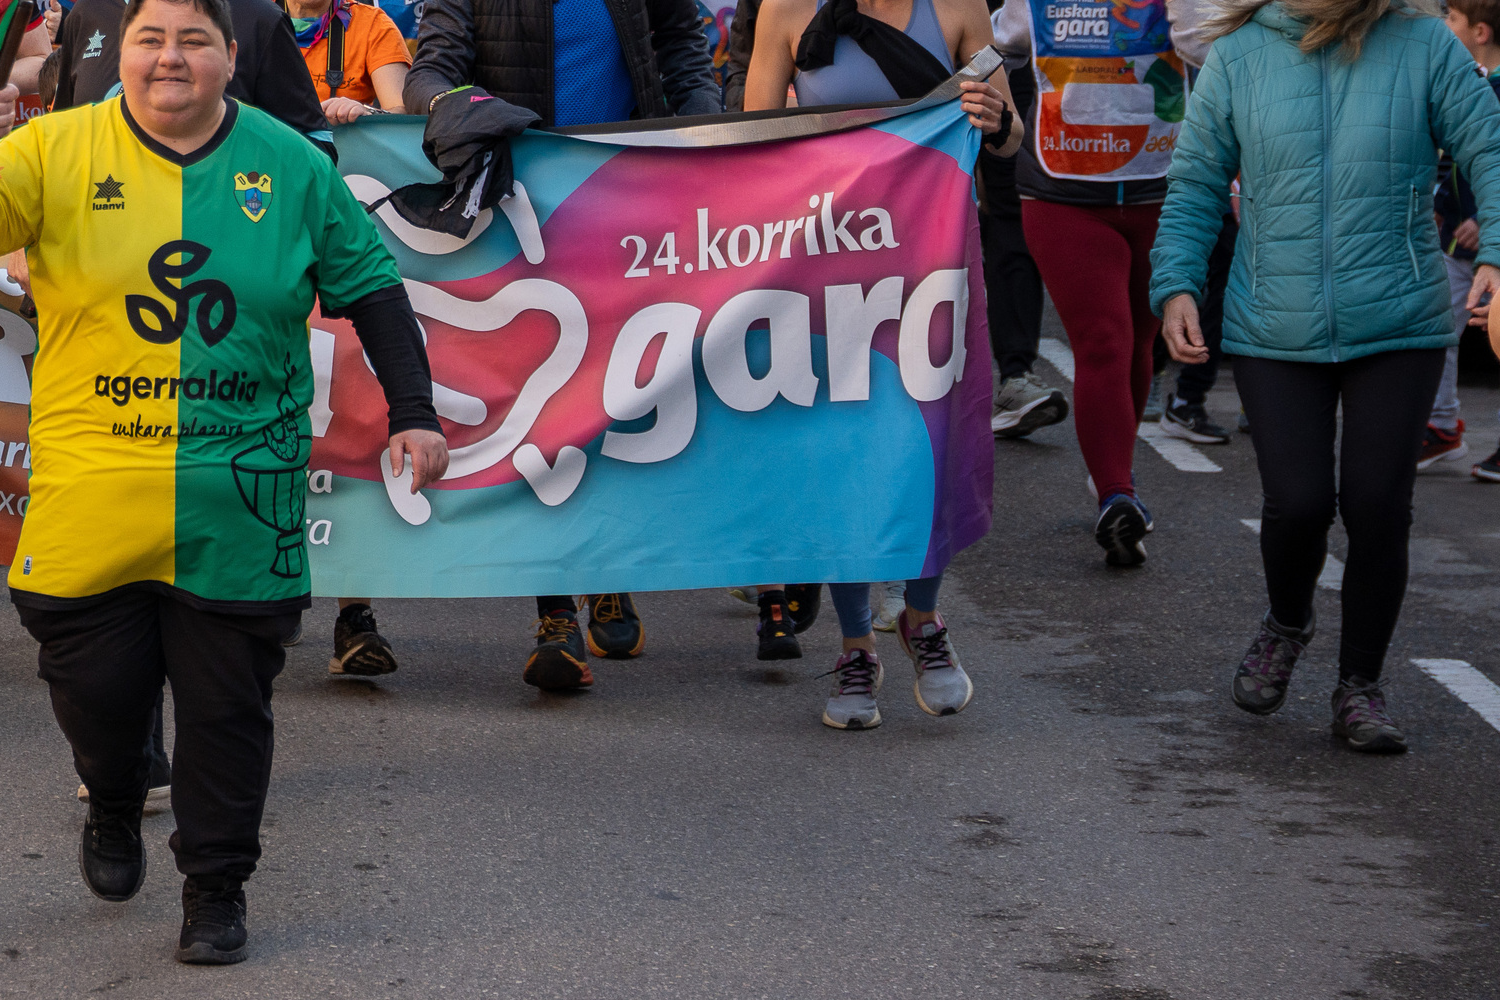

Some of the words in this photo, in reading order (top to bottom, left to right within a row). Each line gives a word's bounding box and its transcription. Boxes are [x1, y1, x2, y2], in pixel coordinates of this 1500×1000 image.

[1046, 3, 1108, 19] Euskara
[1054, 19, 1110, 42] gara
[1043, 131, 1131, 153] 24.korrika
[92, 201, 125, 211] luanvi
[620, 191, 900, 279] 24.korrika
[600, 267, 969, 464] gara
[95, 369, 260, 407] agerraldia
[112, 414, 174, 439] euskara
[178, 416, 243, 441] plazara
